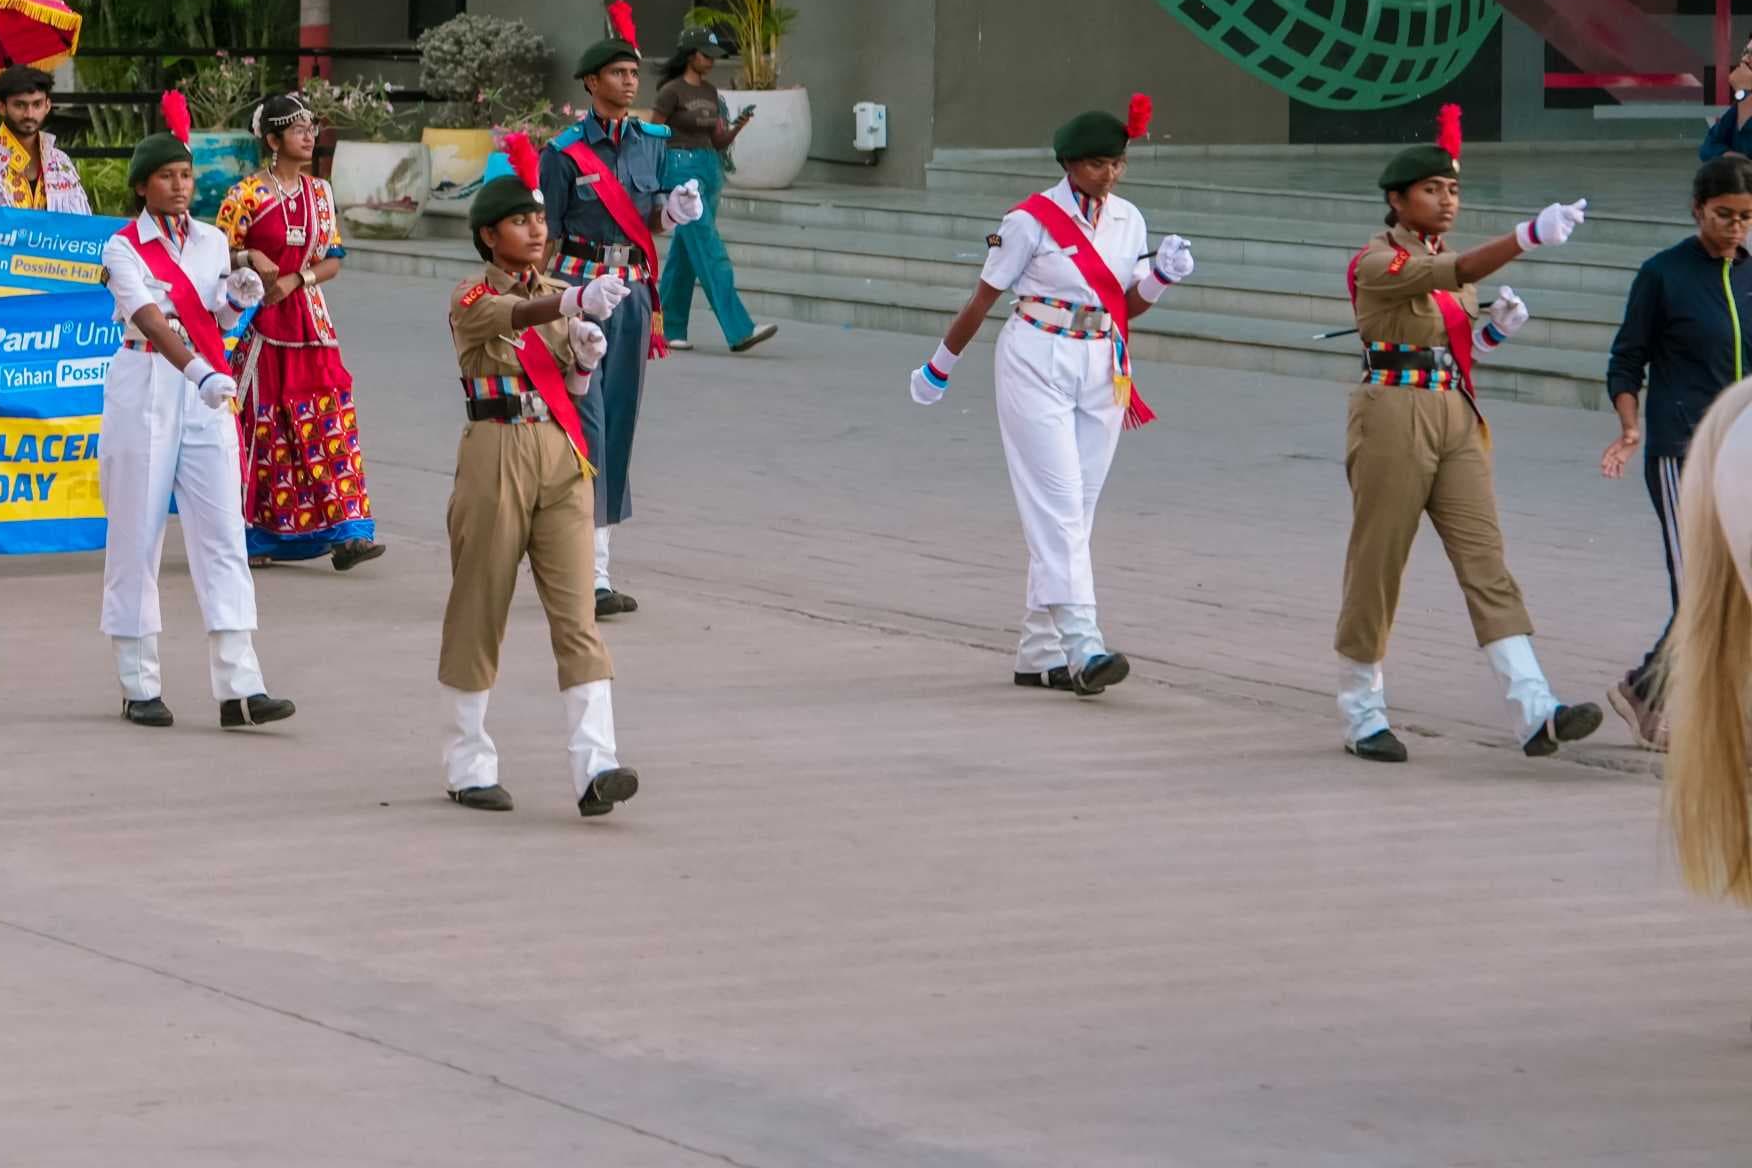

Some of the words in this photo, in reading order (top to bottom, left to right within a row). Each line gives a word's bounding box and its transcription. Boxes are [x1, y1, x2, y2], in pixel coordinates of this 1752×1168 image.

[14, 259, 69, 277] Possible
[70, 267, 99, 281] Hai!
[463, 284, 484, 305] NCC
[3, 368, 53, 387] Yahan
